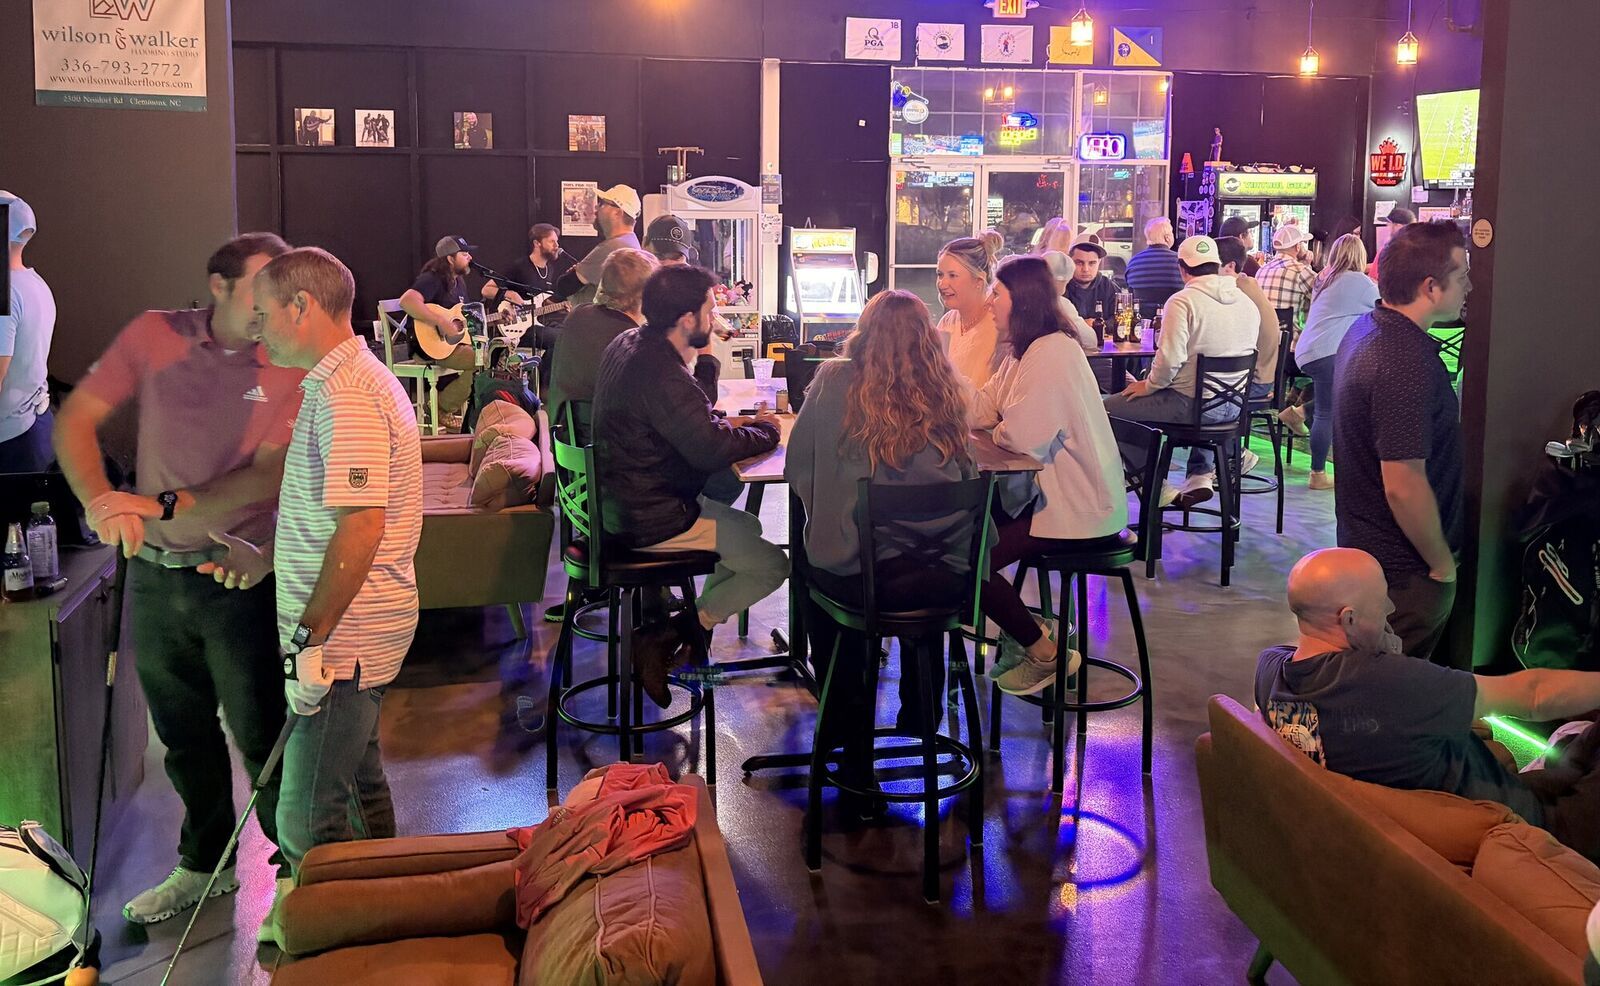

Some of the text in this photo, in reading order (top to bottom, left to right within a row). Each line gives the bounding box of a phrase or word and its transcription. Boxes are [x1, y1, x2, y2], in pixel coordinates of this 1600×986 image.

[999, 0, 1021, 14] EXIT
[890, 21, 899, 29] 18
[42, 26, 199, 50] wilson & walker
[171, 50, 199, 58] STUDIO
[61, 58, 181, 77] 336-793-2772
[50, 75, 193, 89] www.wilsonwalkerfloors.com
[113, 96, 123, 104] Rd
[169, 99, 182, 107] NC
[1371, 155, 1387, 171] WE
